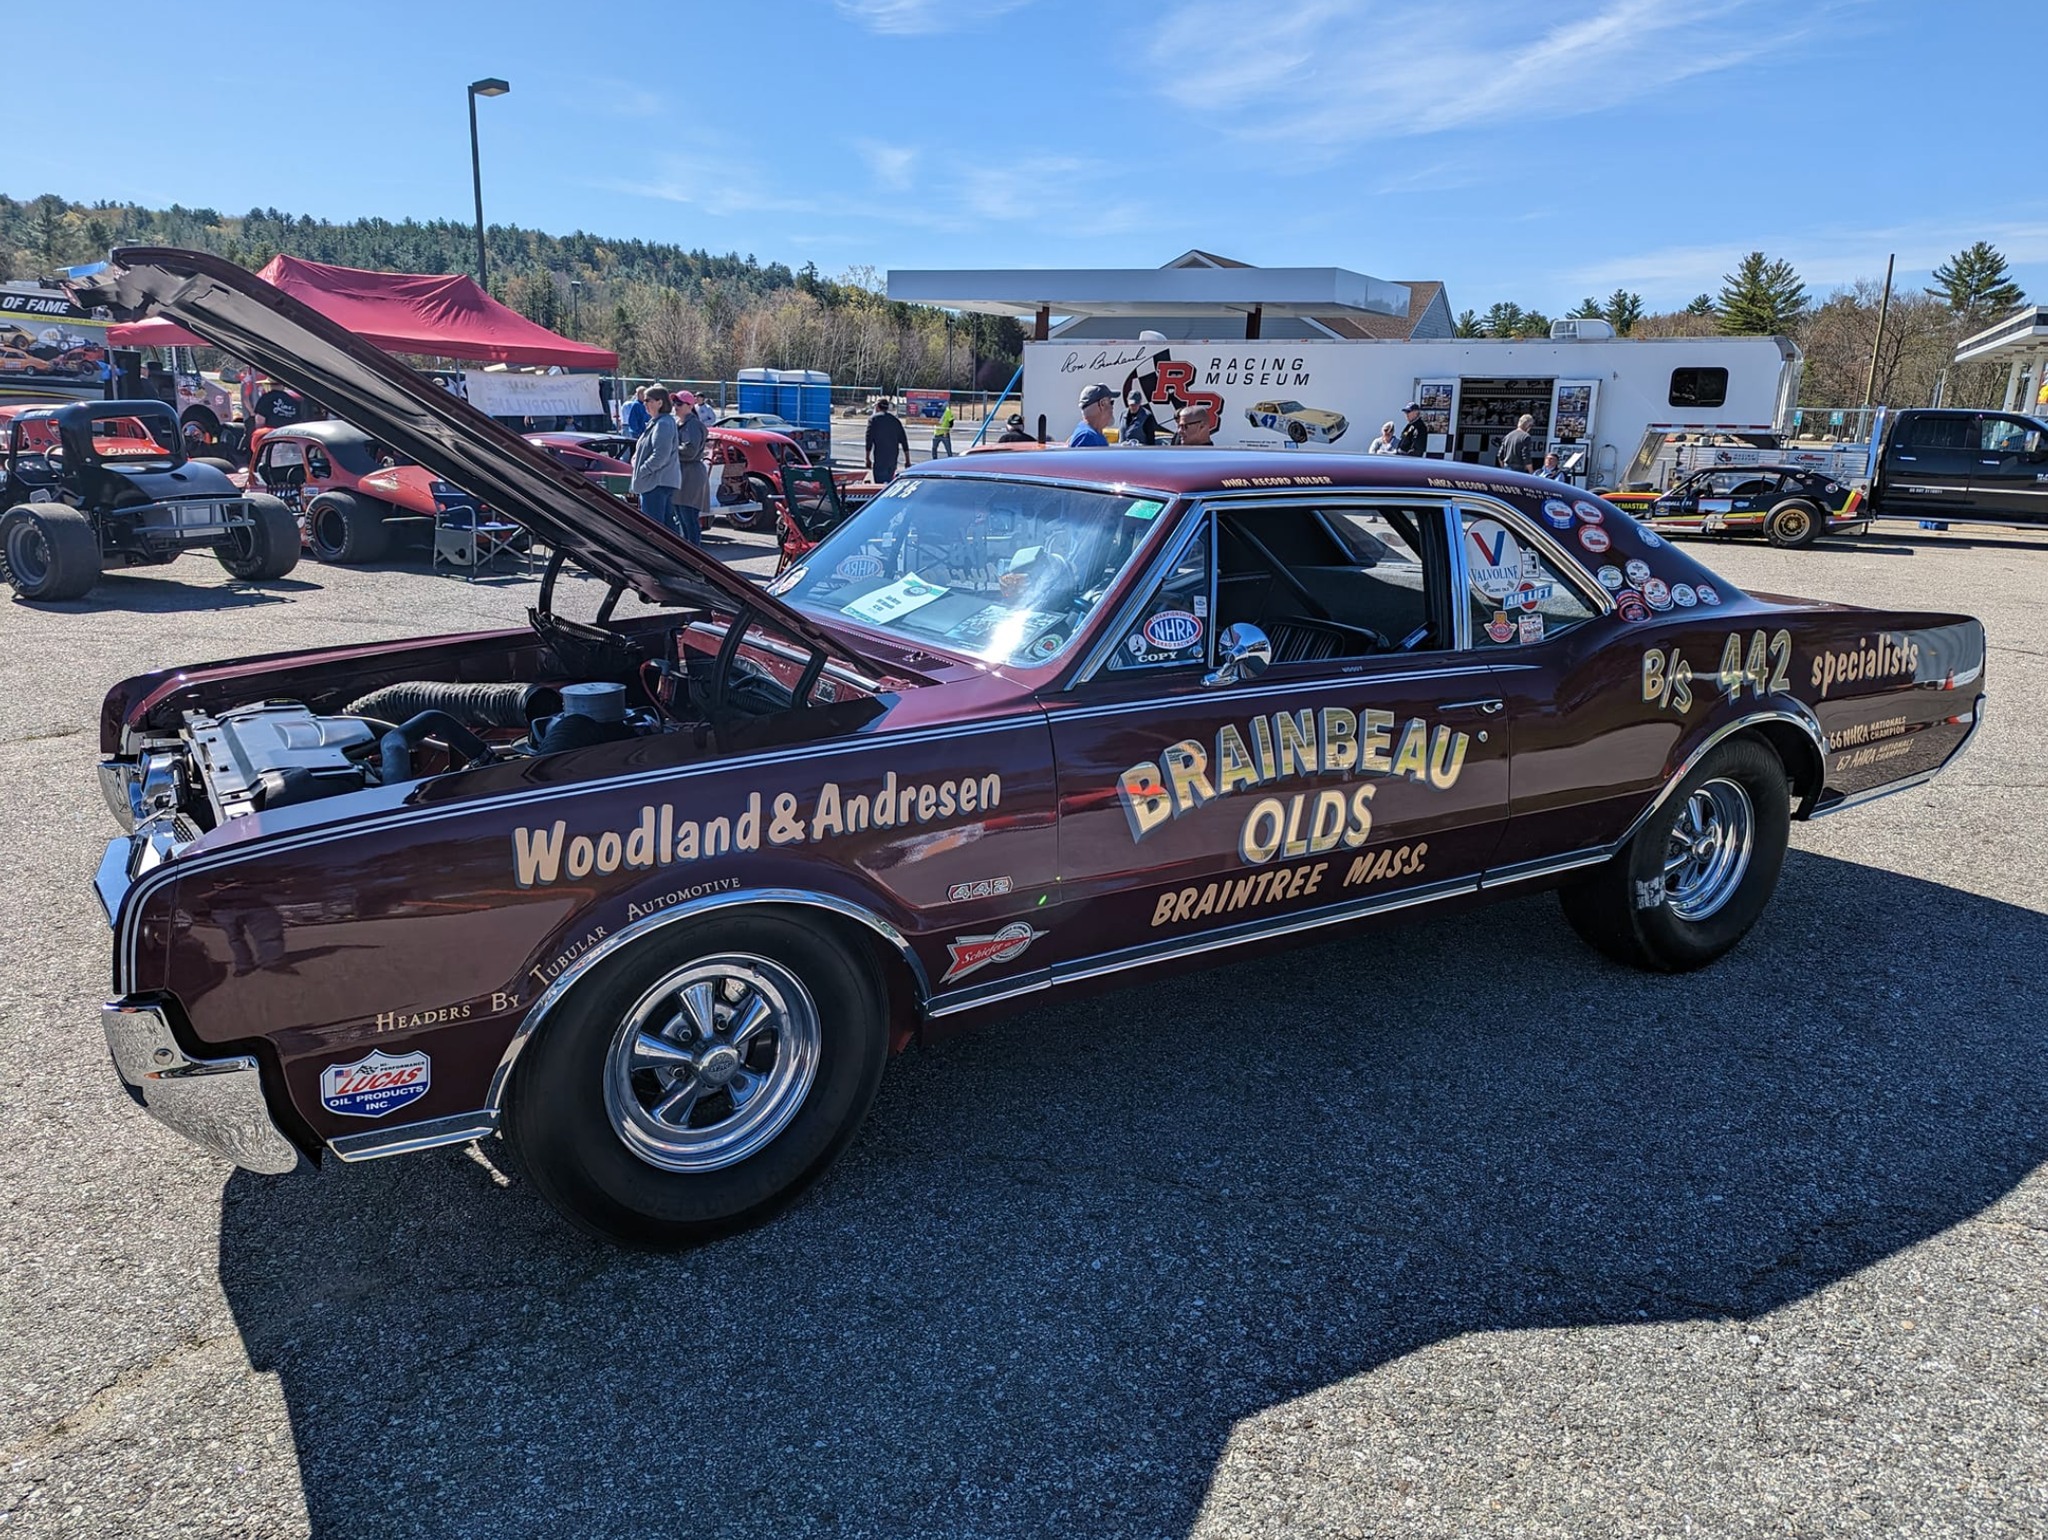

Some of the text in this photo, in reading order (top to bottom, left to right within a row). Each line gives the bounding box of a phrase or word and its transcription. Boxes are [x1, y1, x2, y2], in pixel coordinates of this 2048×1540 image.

[2, 296, 70, 314] OF FAME
[1210, 358, 1305, 371] RACING
[1205, 373, 1310, 386] MUSEUM
[1261, 414, 1278, 428] 47
[1251, 477, 1291, 486] RECORD
[1293, 476, 1333, 485] HOLDER
[1455, 480, 1488, 491] RECORD
[1490, 483, 1522, 495] HOLDER
[1470, 565, 1519, 580] VALVOLINE
[1507, 585, 1552, 606] AIR LIFT
[1154, 619, 1194, 641] NHRA
[1138, 651, 1178, 662] COPY
[1642, 629, 1918, 714] B/S 442 specialists
[1870, 716, 1907, 730] NATIONALS
[1843, 725, 1869, 748] NHRA
[1870, 724, 1906, 740] CHAMPION
[1878, 739, 1914, 752] NATIONALS
[1117, 706, 1470, 843] BRAINBEAU
[513, 771, 1001, 888] Woodland & Andresen
[1239, 784, 1377, 865] OLDS
[952, 879, 1009, 900] 442
[1151, 842, 1428, 927] BRAINTREE MASS.
[380, 1061, 425, 1072] PERFORMANCE
[336, 1067, 423, 1095] LUCAS
[329, 1085, 424, 1107] OIL PRODUCTS
